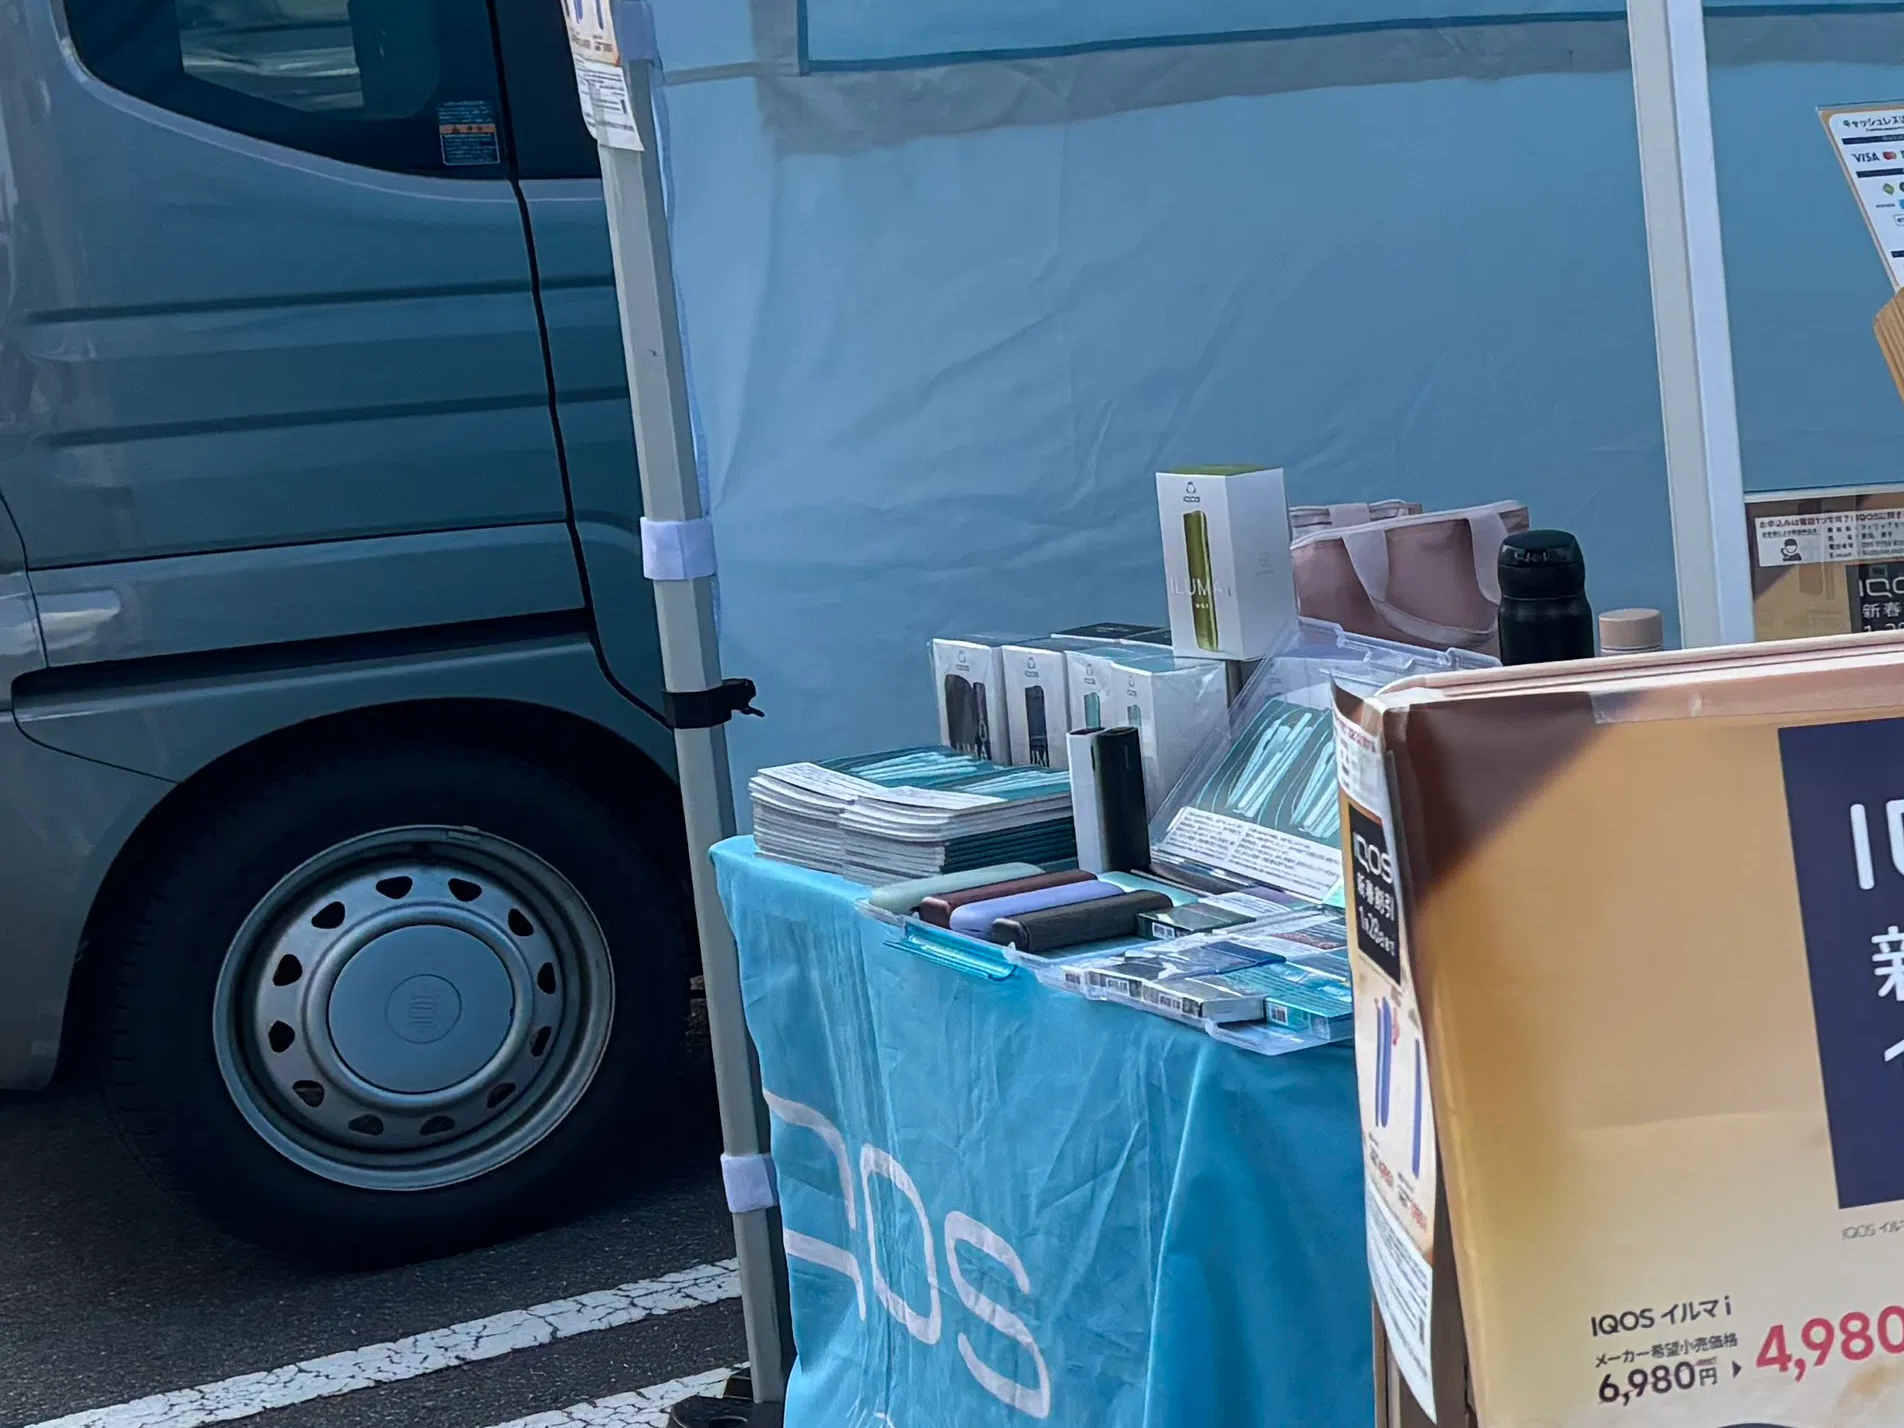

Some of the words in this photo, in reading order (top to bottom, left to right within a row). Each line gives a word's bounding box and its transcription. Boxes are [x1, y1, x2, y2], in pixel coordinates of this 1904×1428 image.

[1852, 152, 1881, 163] VISA
[1590, 1307, 1655, 1337] IQOS
[1660, 1299, 1720, 1327] イルマ
[1594, 1332, 1739, 1369] メーカー希望小売価格
